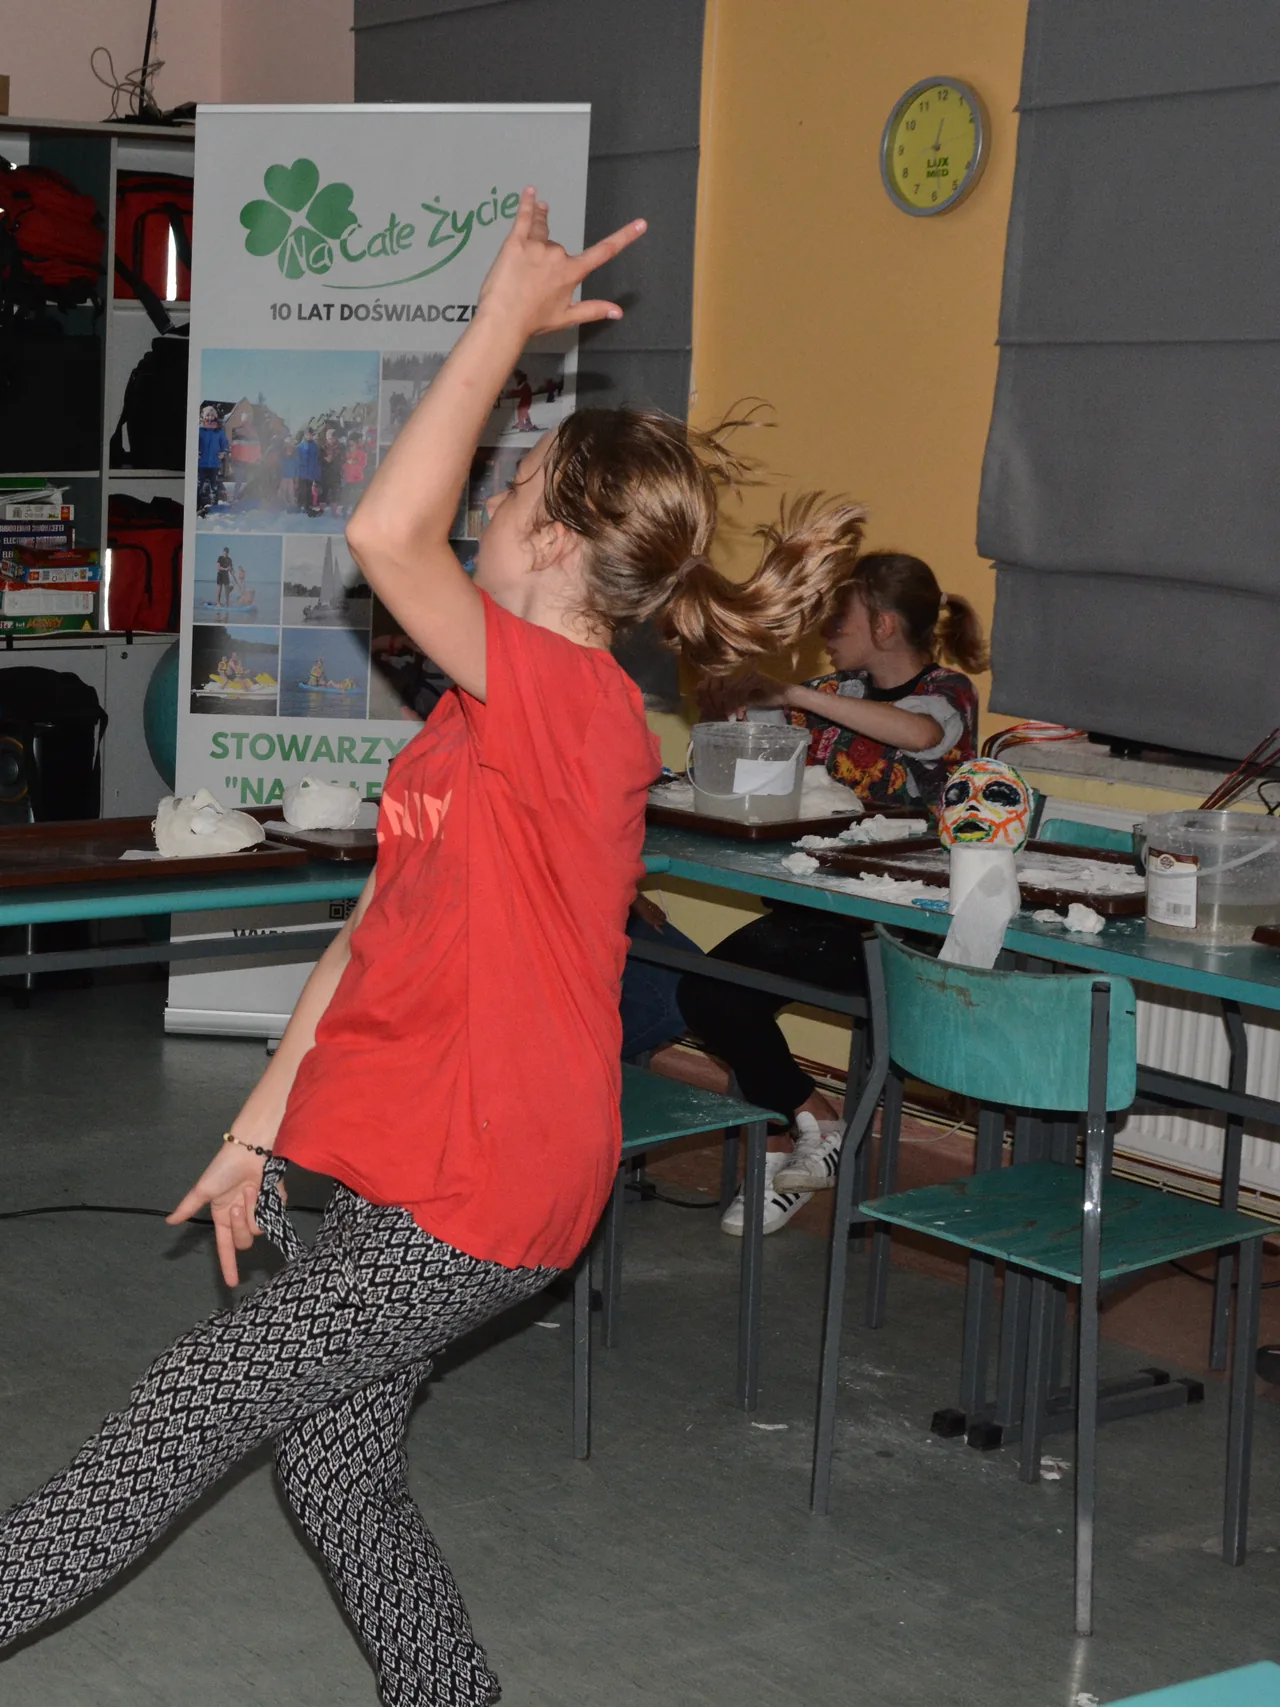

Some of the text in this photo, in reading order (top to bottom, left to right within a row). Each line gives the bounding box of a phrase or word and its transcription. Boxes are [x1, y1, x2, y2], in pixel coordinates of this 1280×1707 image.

[937, 89, 949, 101] 12
[919, 102, 930, 112] 11
[905, 120, 916, 131] 10
[927, 157, 949, 168] LUX
[282, 232, 333, 281] Na
[339, 212, 416, 263] Całe
[270, 303, 291, 321] 10
[297, 303, 333, 321] LAT
[209, 731, 409, 765] STOWARZY
